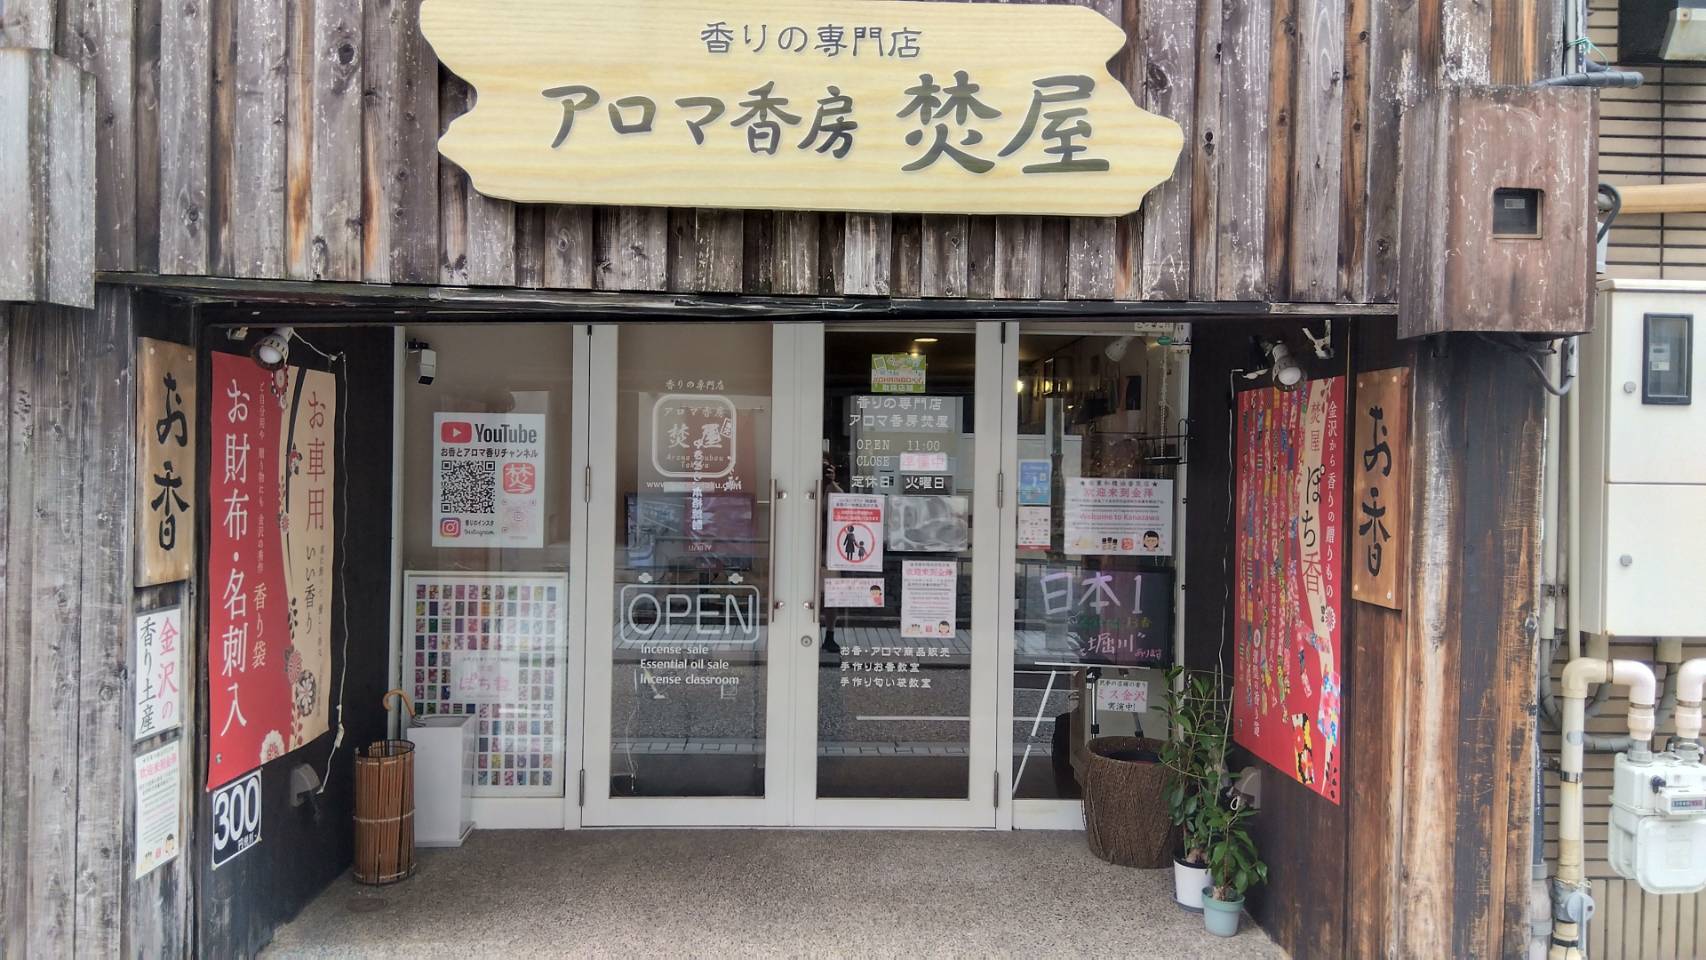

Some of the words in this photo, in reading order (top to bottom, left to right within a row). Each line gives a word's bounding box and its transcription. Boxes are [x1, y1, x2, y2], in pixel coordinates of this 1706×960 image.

[701, 22, 923, 59] 香りの専門店
[541, 81, 859, 160] アロマ香房
[896, 69, 1111, 175] 焚屋
[665, 379, 725, 391] 香りの専門店
[856, 396, 942, 411] 香りの専門店
[849, 414, 949, 428] アロマ香房焚屋
[474, 423, 537, 443] YouTube
[441, 447, 538, 458] お香とアロマ香りチャンネル
[856, 439, 890, 450] OPEN
[907, 440, 940, 451] 11:00
[151, 372, 190, 550] お香
[306, 391, 326, 532] お車用
[856, 456, 889, 467] CLOSE
[851, 475, 890, 488] 定休日
[905, 475, 945, 489] 火曜日
[1358, 405, 1392, 577] お香
[1325, 400, 1338, 598] 金沢から香りの贈りもの
[1302, 464, 1326, 595] ぽち香
[221, 378, 250, 736] お財布・名刺入
[628, 593, 753, 634] OPEN
[252, 582, 268, 669] 香り袋
[641, 644, 681, 654] Incense
[686, 644, 709, 654] sale
[840, 647, 951, 658] お香・アロマ商品販売
[157, 616, 179, 720] 金沢の
[640, 659, 687, 670] Essential
[691, 659, 704, 669] oil
[707, 659, 729, 670] sale
[840, 662, 920, 673] 手作りお香教室
[138, 616, 156, 734] 香り土産
[640, 673, 682, 685] Incense
[685, 673, 739, 685] classroom
[840, 678, 932, 689] 手作り匂い袋教室
[214, 777, 259, 851] 300
